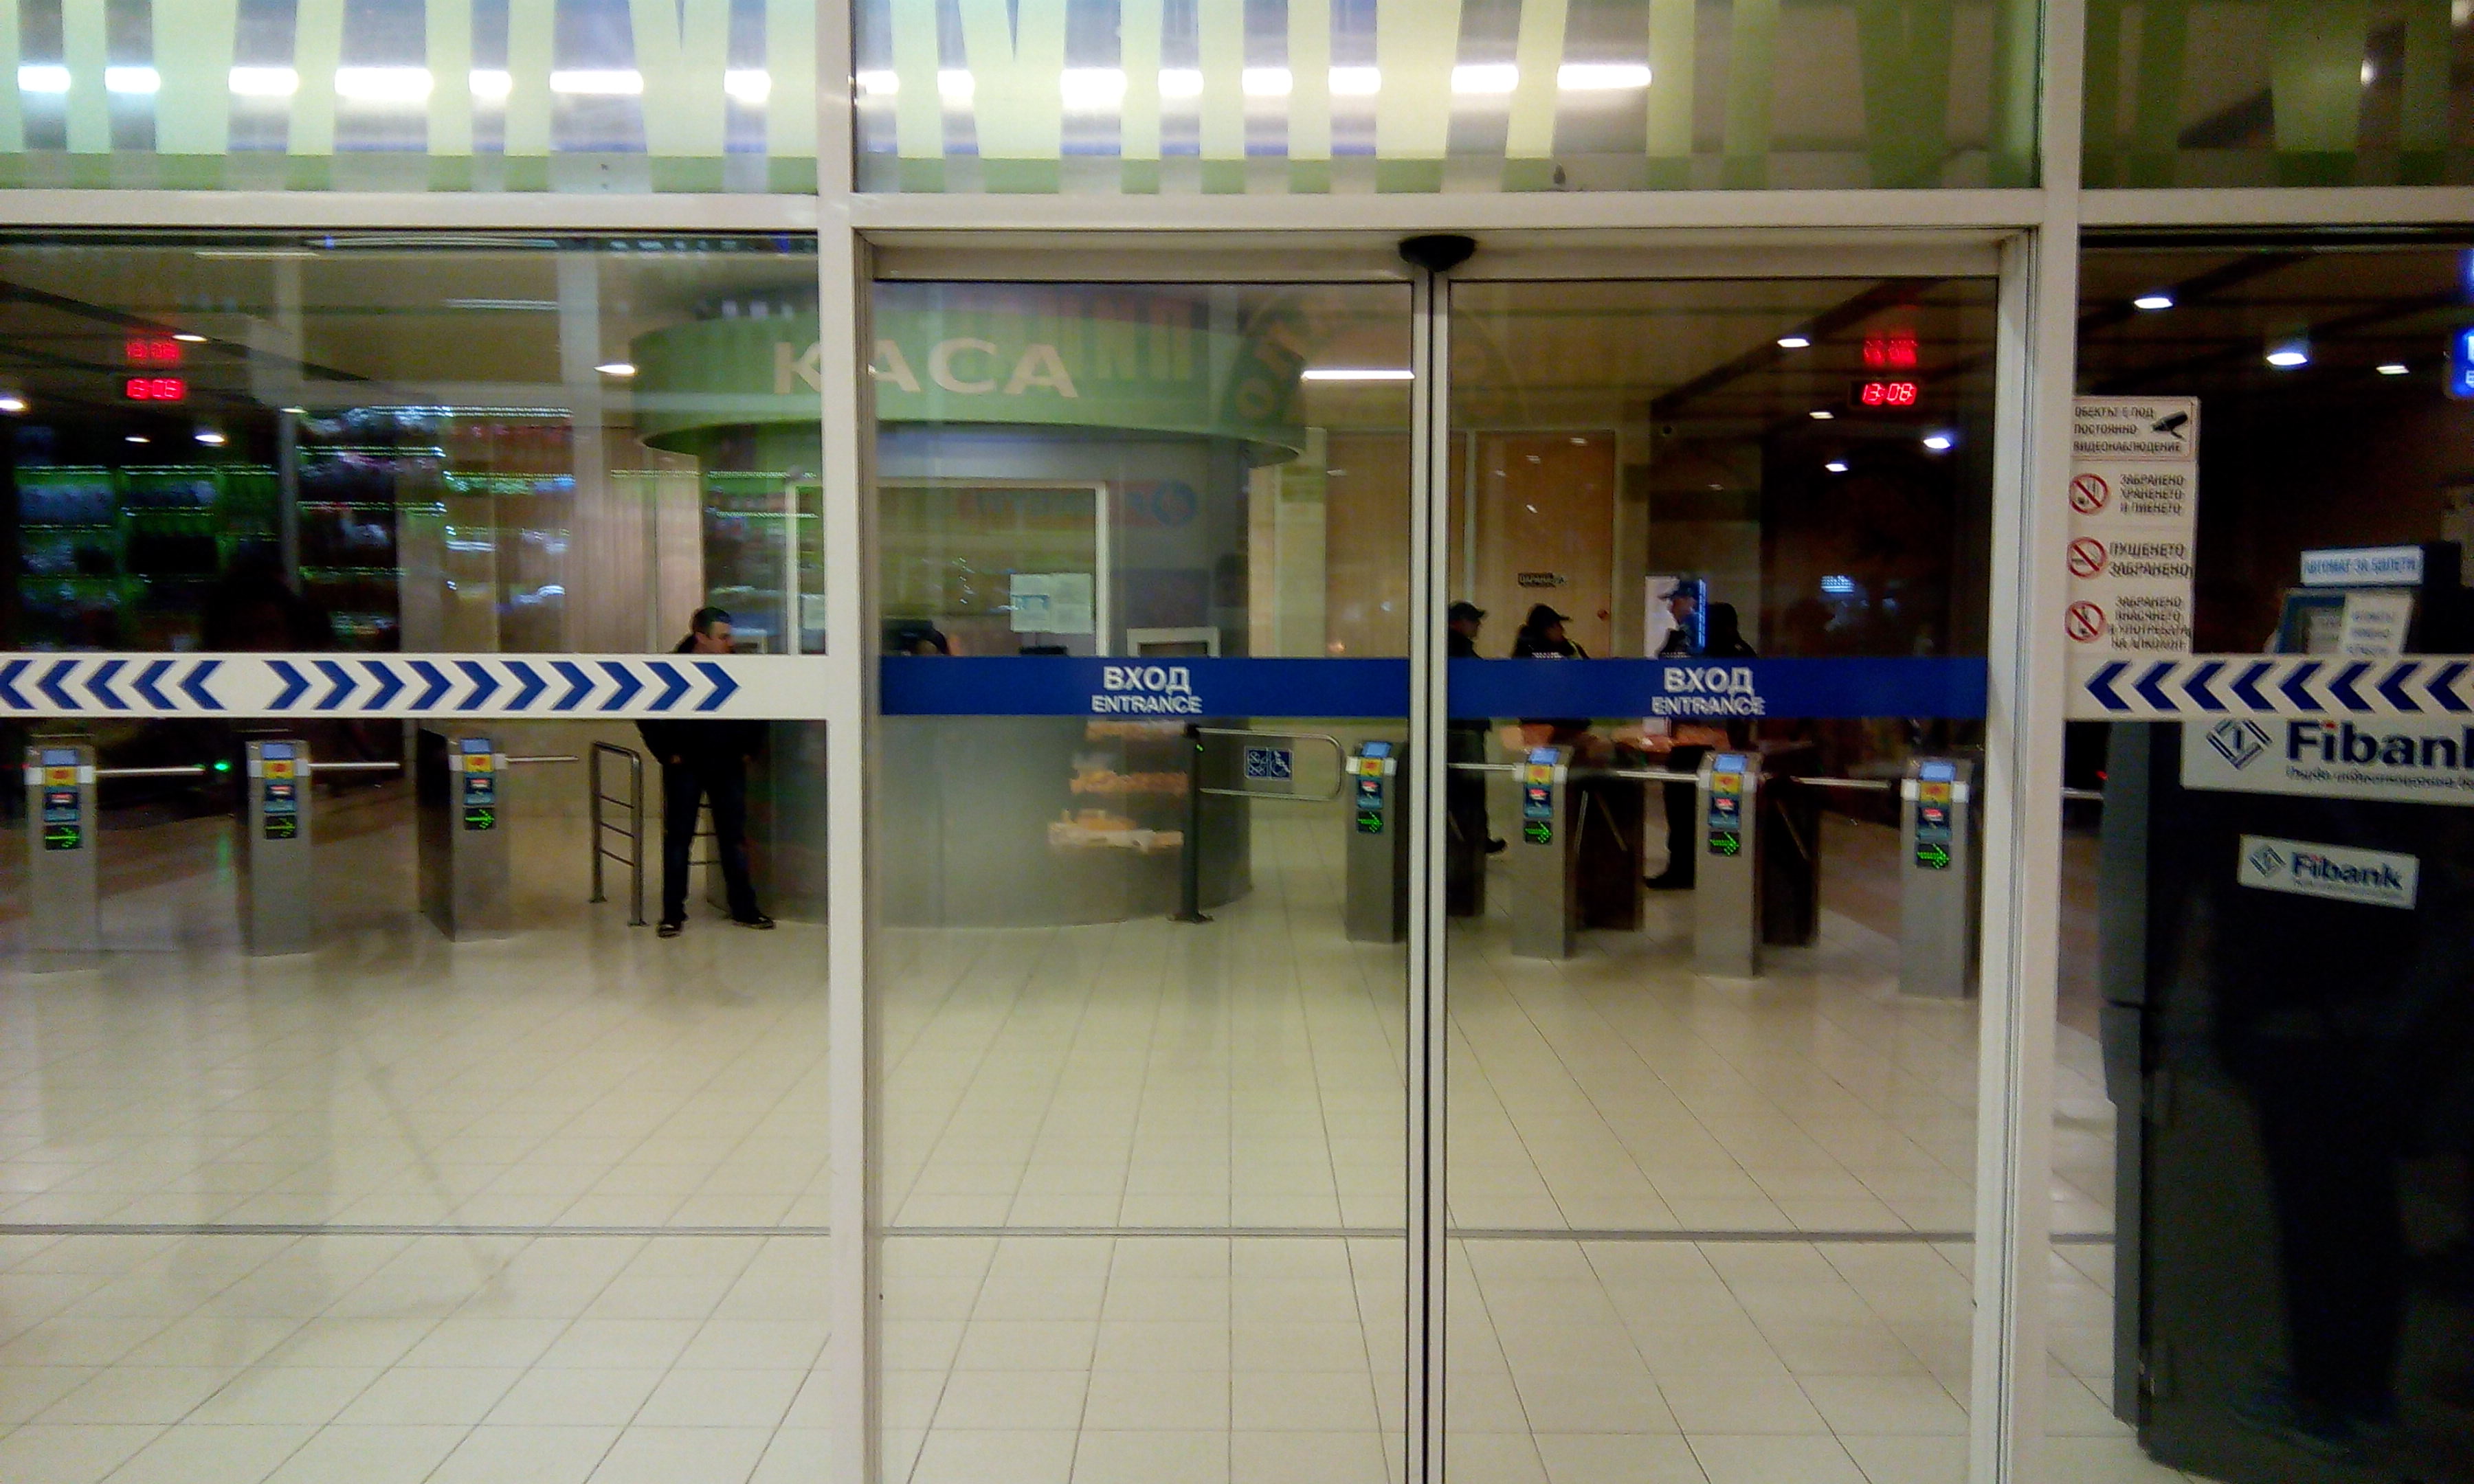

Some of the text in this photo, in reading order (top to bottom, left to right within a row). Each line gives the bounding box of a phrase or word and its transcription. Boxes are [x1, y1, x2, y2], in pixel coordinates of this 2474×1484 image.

[774, 337, 1079, 398] КАСА
[1862, 382, 1917, 404] 13:08
[2130, 407, 2154, 418] ПОД
[2074, 423, 2139, 435] ПОСТОЯННО
[2073, 441, 2181, 453] ВИДЕОНАБЛЮДЕНИЕ
[2121, 474, 2185, 486] ЗАБРАНЕНО
[2110, 542, 2185, 558] ПУШЕНЕТО
[1103, 665, 1192, 695] ВХОД
[1664, 666, 1755, 697] ВХОД
[1091, 695, 1203, 714] ENTRANCE
[1651, 695, 1765, 715] ENTRANCE
[2292, 851, 2403, 890] Fibank
